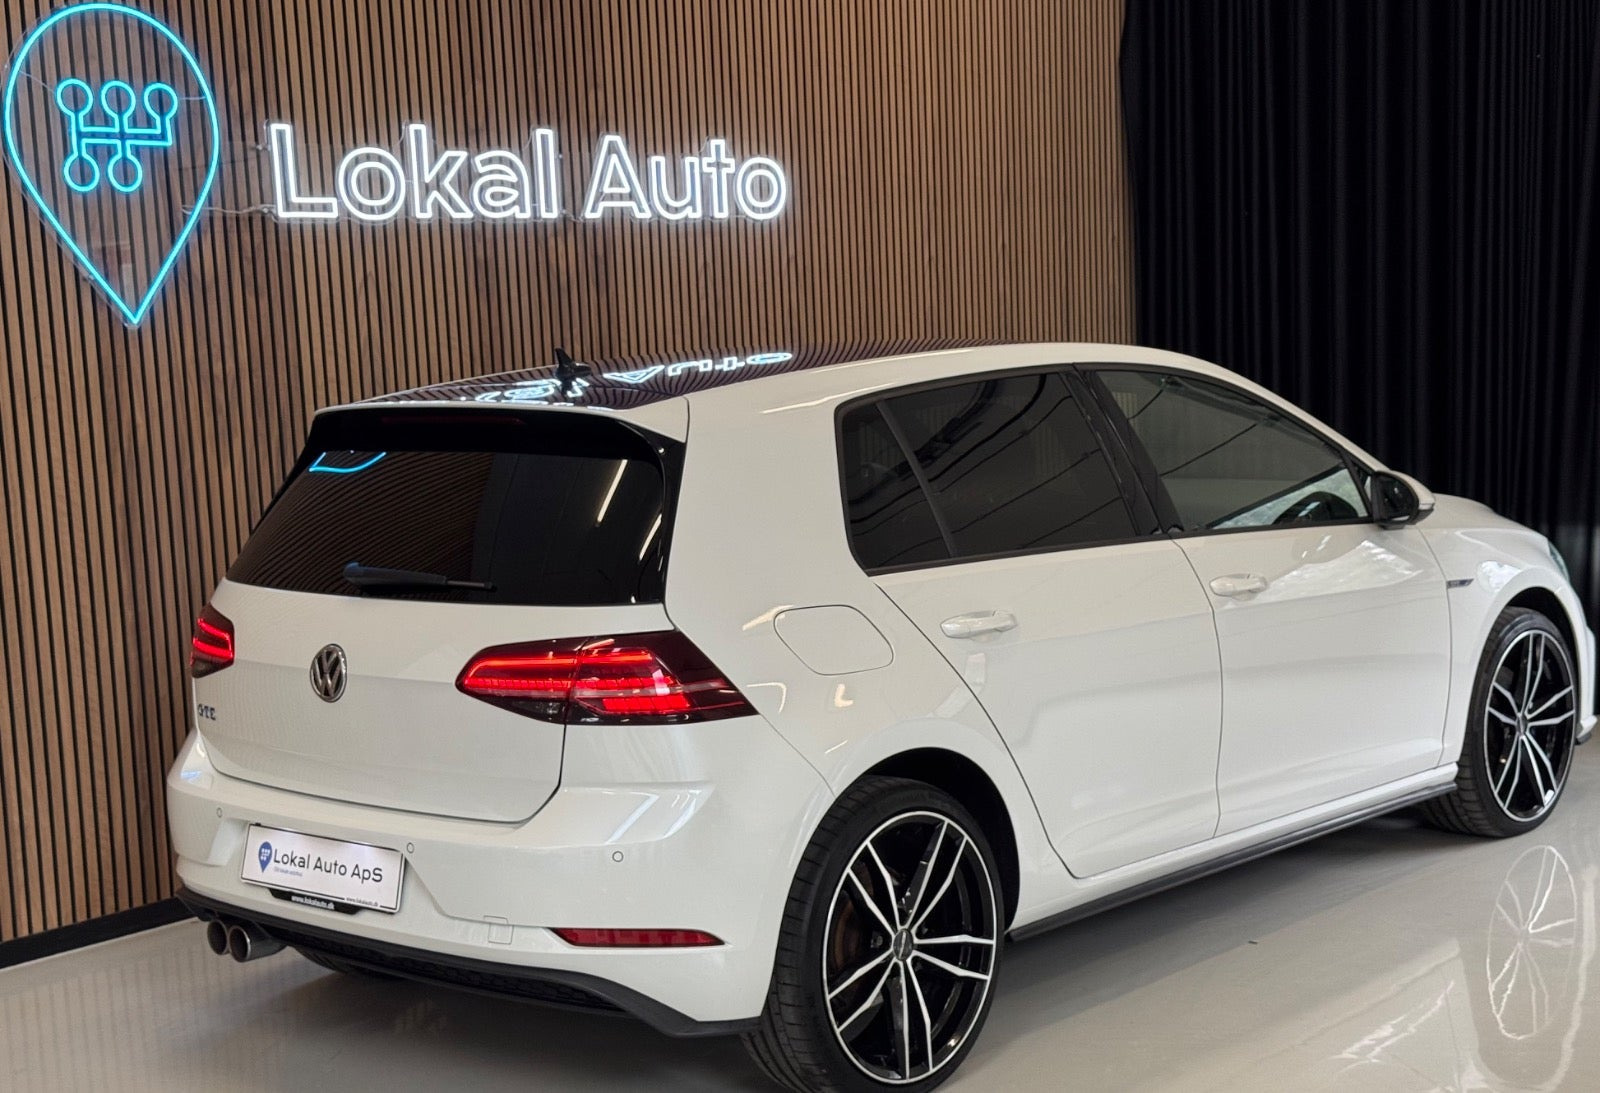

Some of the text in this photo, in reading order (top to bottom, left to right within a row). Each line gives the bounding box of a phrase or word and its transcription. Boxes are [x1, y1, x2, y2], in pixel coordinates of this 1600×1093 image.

[269, 122, 787, 220] Lokal Auto
[273, 848, 311, 869] Lokal
[313, 856, 348, 877] Auto
[350, 863, 383, 884] ApS
